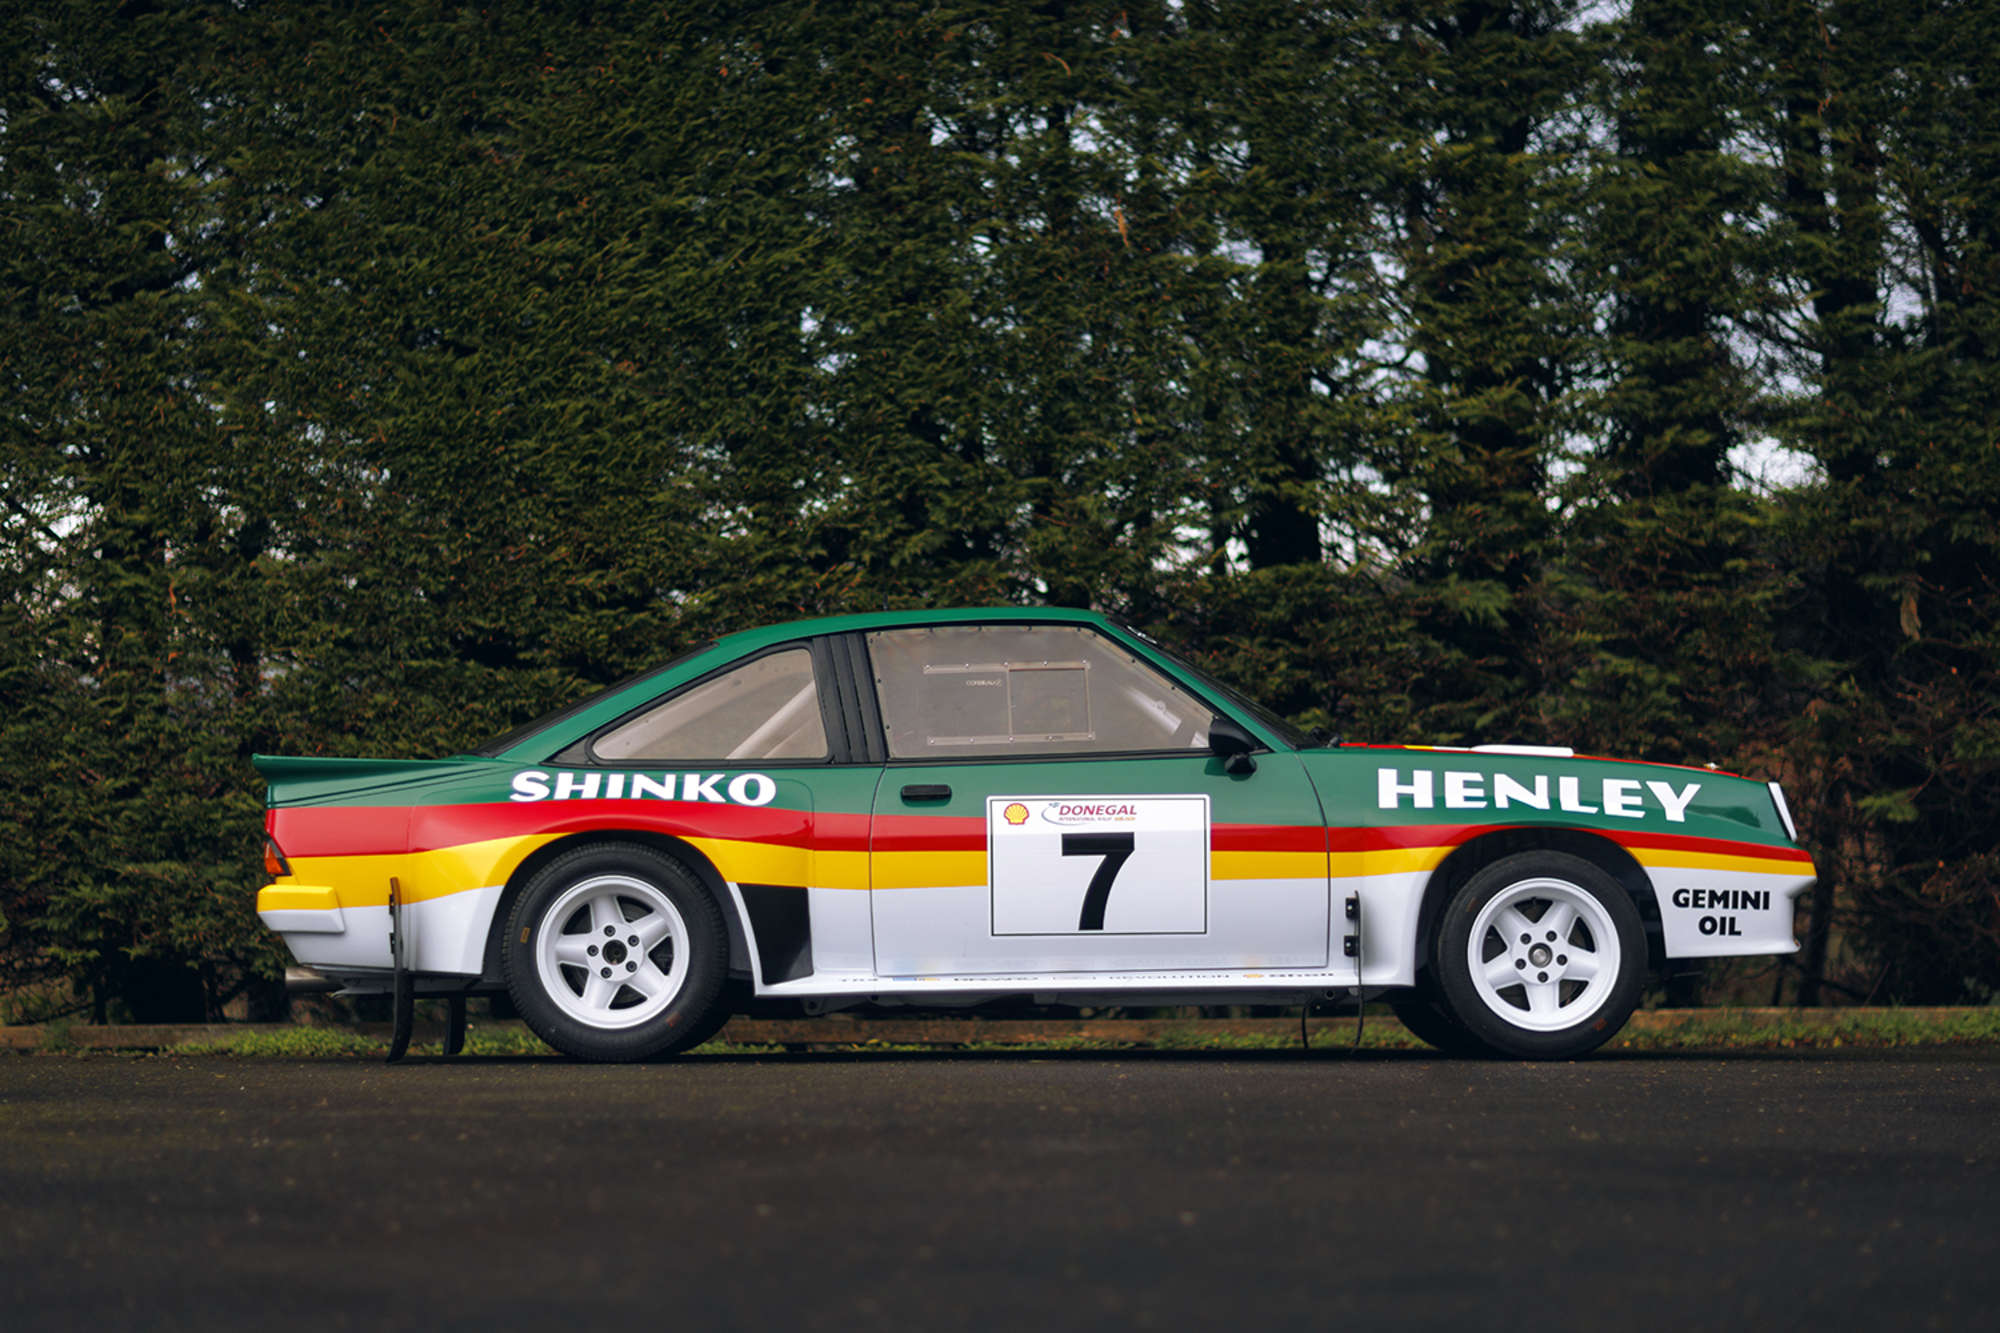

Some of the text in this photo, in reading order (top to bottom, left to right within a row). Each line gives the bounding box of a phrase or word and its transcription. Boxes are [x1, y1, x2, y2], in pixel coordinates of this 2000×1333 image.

[510, 771, 777, 806] SHINKO
[1378, 768, 1701, 823] HENLEY
[1058, 804, 1137, 815] DONEGAL
[1061, 832, 1135, 931] 7
[1672, 888, 1771, 910] GEMINI
[1698, 916, 1742, 937] OIL
